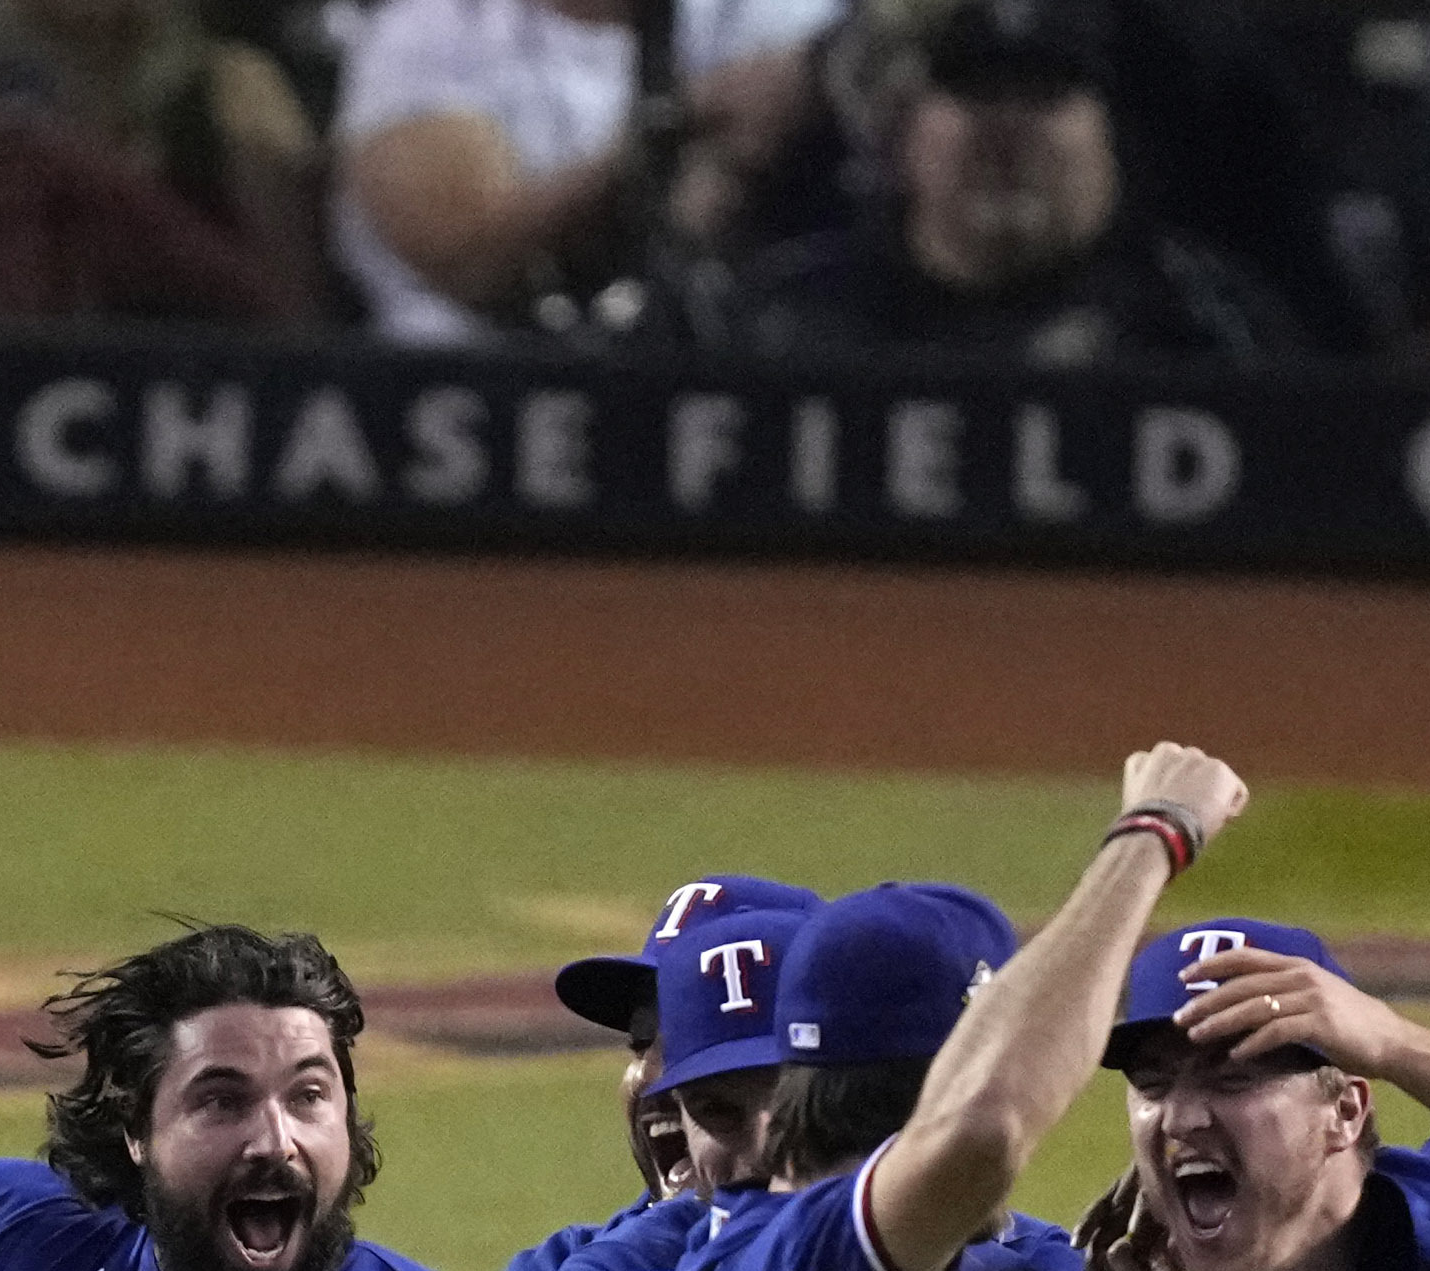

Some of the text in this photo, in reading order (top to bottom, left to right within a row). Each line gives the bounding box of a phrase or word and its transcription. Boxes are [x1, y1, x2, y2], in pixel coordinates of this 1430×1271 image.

[13, 377, 1243, 526] CHASE FIELD
[656, 883, 726, 943] T
[700, 939, 771, 1014] T
